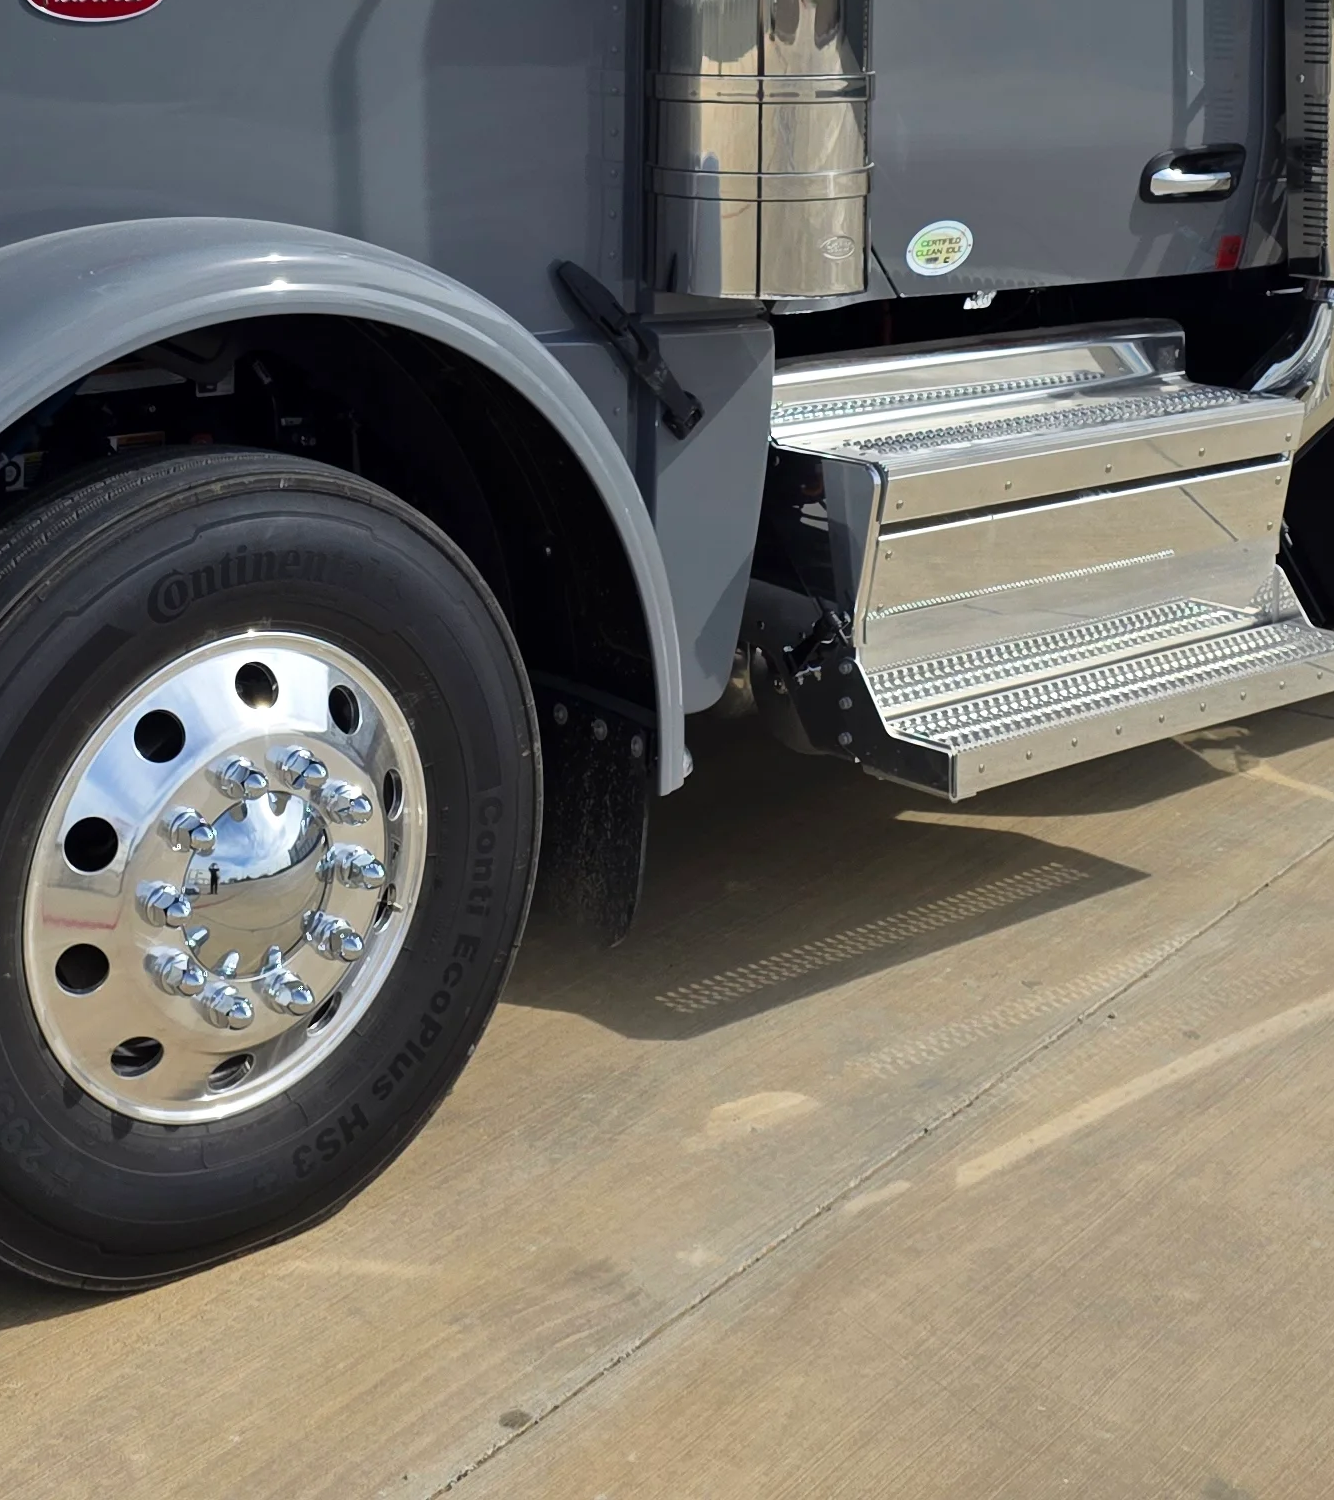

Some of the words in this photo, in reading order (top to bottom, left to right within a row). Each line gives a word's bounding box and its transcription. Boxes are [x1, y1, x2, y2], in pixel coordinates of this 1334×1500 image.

[916, 248, 943, 258] CLEAN
[945, 245, 963, 254] IDLE
[921, 237, 962, 247] CERTIFIED
[464, 792, 503, 918] Conti
[369, 932, 483, 1110] EcoPlus
[289, 1102, 371, 1182] HS3
